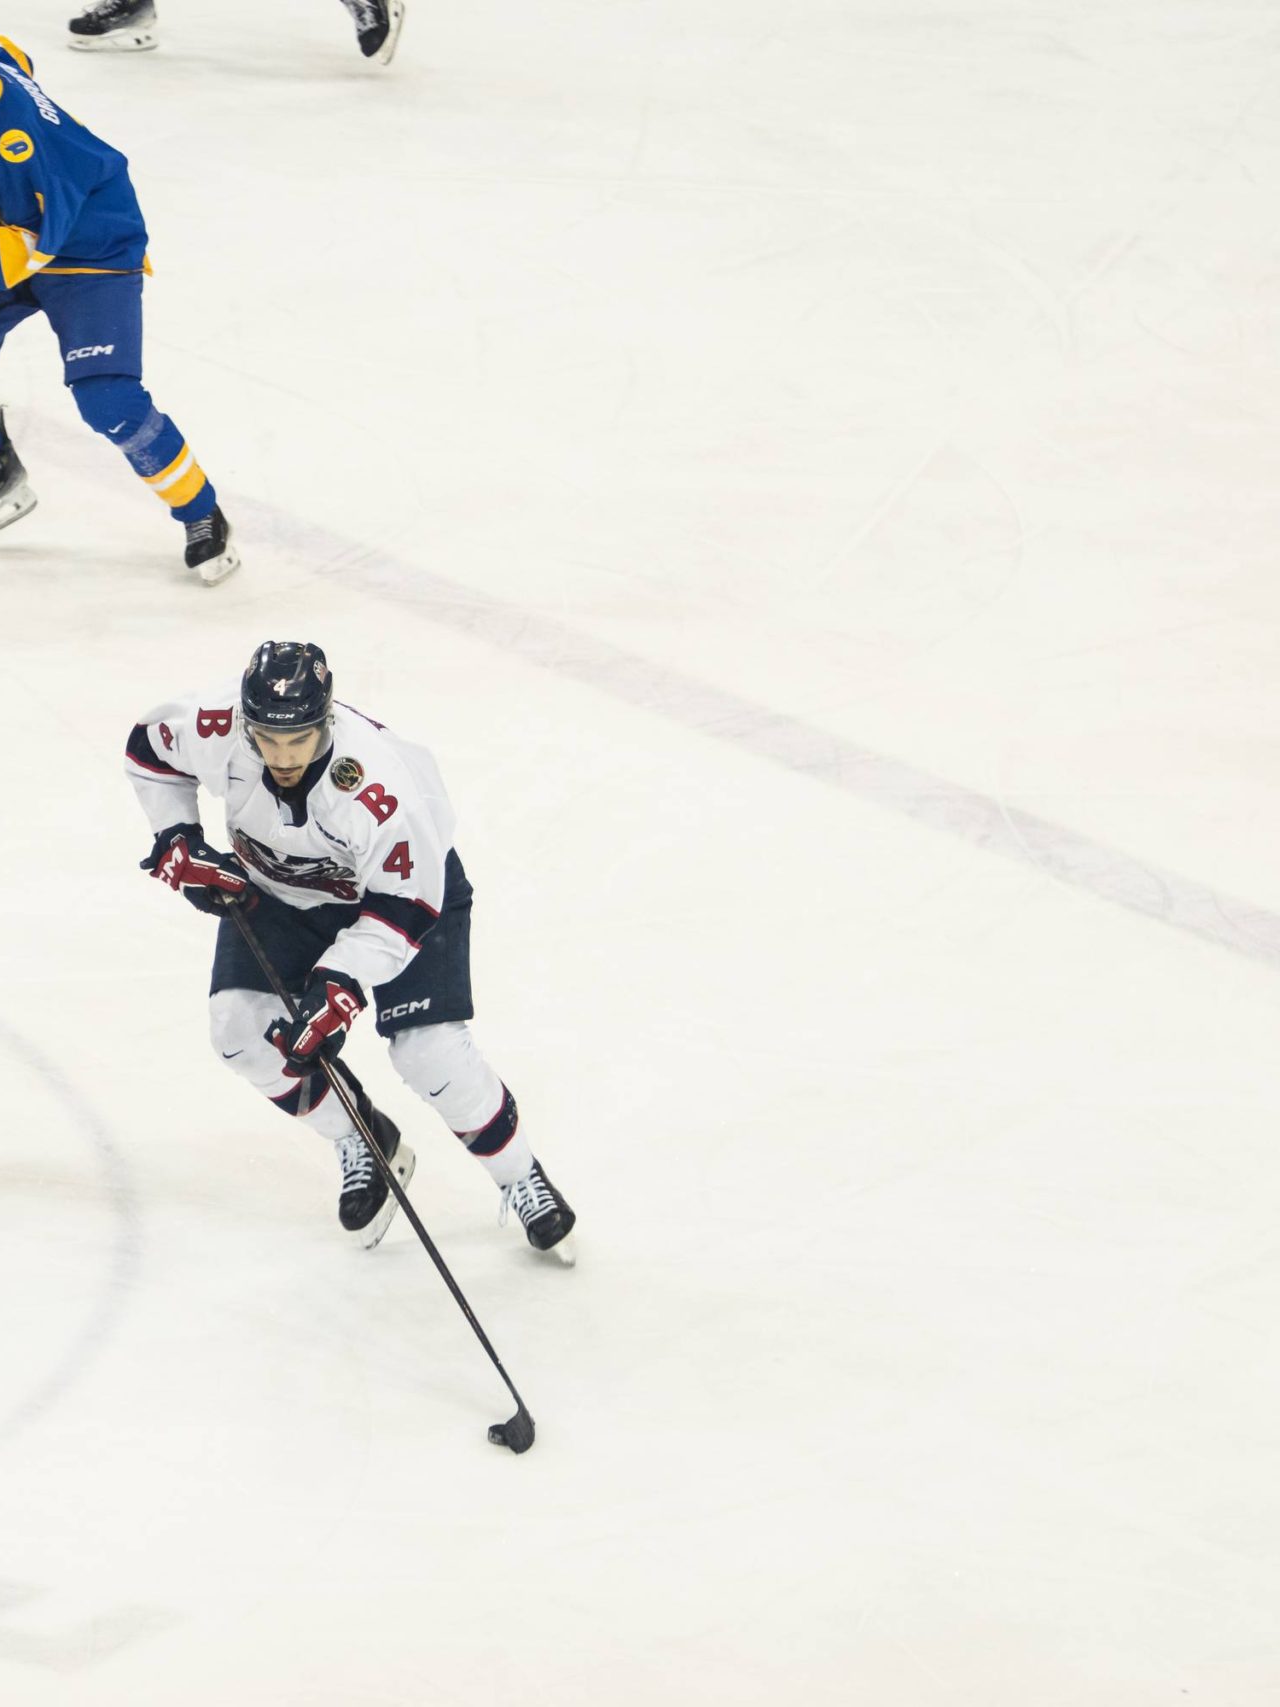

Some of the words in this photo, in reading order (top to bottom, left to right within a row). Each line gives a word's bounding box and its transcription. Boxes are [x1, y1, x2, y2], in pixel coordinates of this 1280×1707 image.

[66, 344, 115, 362] CCM
[273, 678, 287, 696] 4
[196, 706, 234, 739] B
[354, 783, 399, 827] B
[382, 841, 414, 880] 4
[380, 998, 431, 1022] CCM
